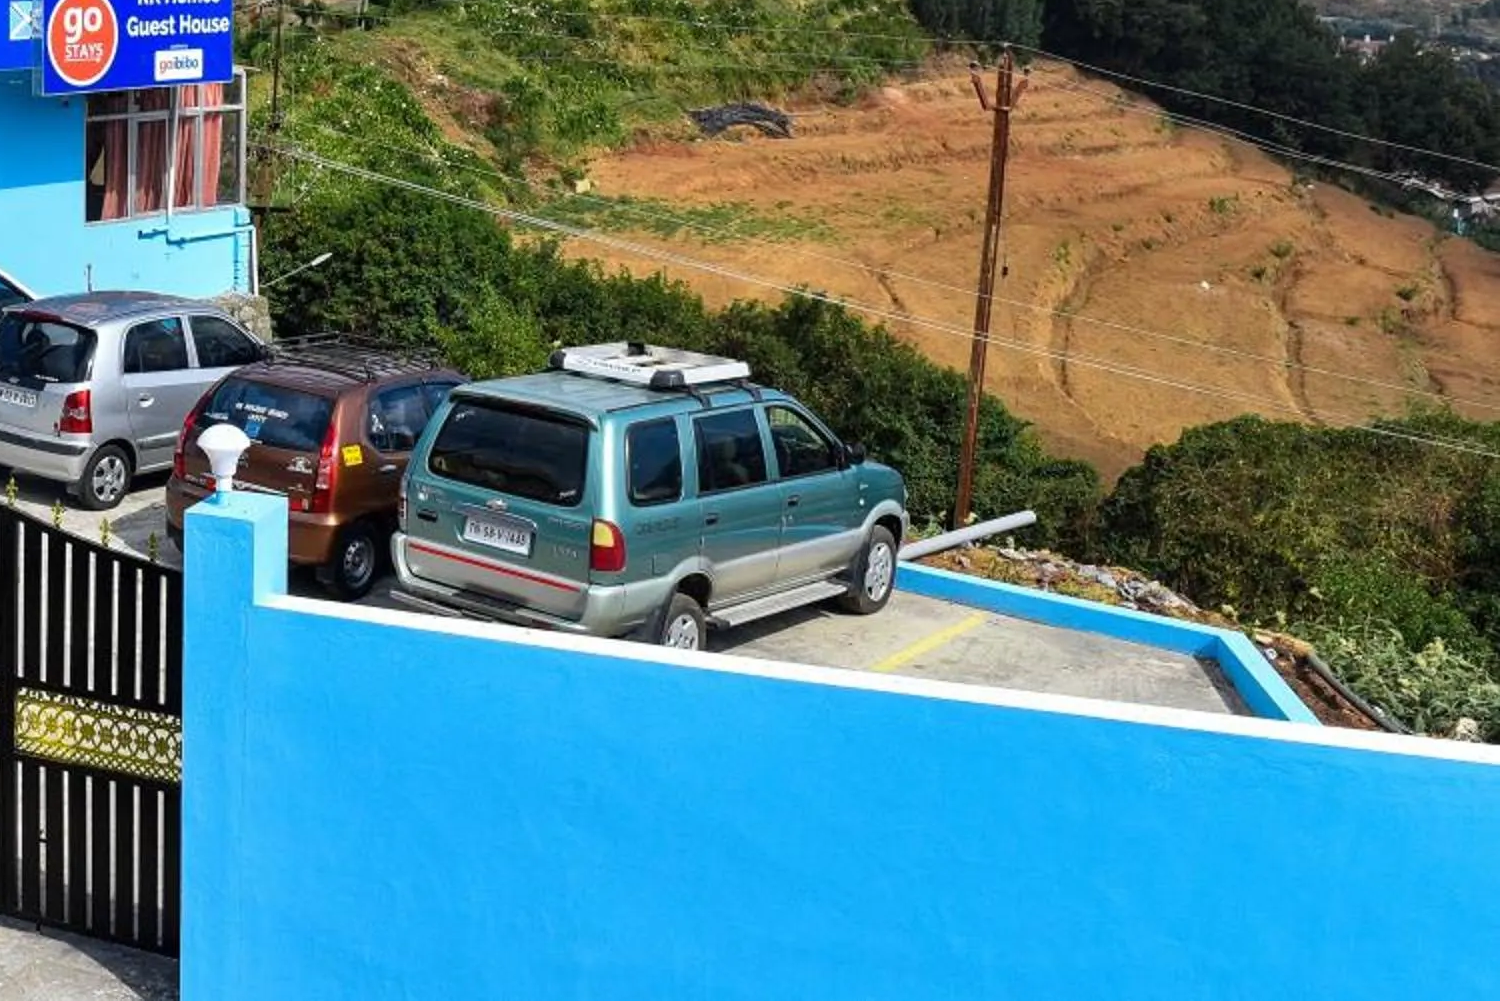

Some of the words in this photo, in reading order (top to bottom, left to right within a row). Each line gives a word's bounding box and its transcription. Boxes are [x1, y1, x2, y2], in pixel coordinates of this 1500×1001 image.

[63, 5, 104, 44] go
[126, 14, 176, 38] Guest
[178, 13, 230, 35] House
[64, 43, 104, 62] STAYS
